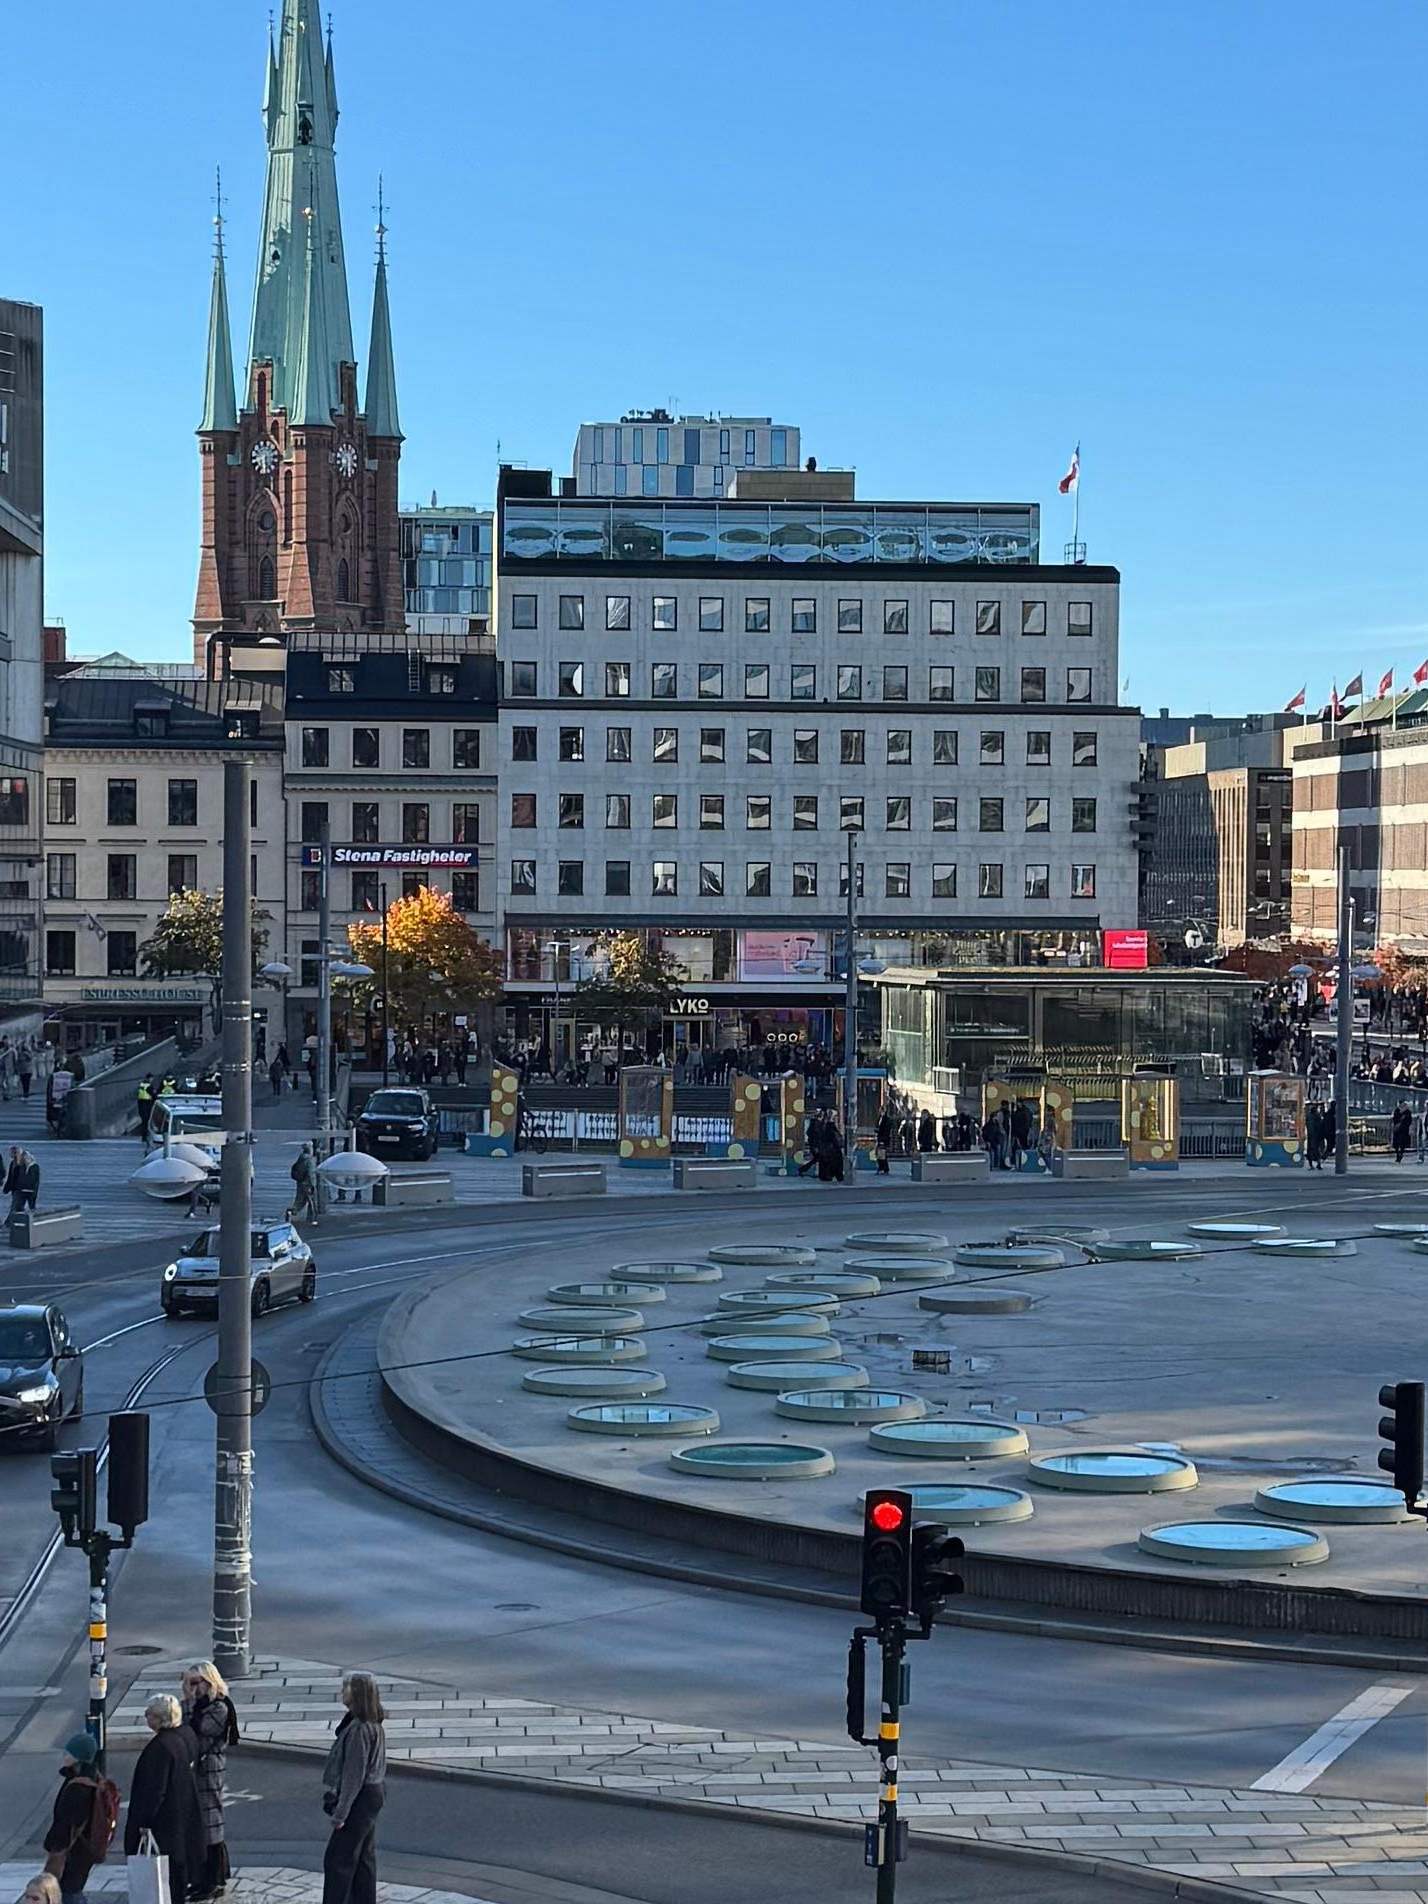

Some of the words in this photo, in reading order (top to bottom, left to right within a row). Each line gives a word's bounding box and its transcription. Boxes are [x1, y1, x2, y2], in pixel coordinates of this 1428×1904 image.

[334, 848, 380, 862] Stena
[383, 848, 471, 865] Fastigheter
[669, 998, 709, 1014] LYKO
